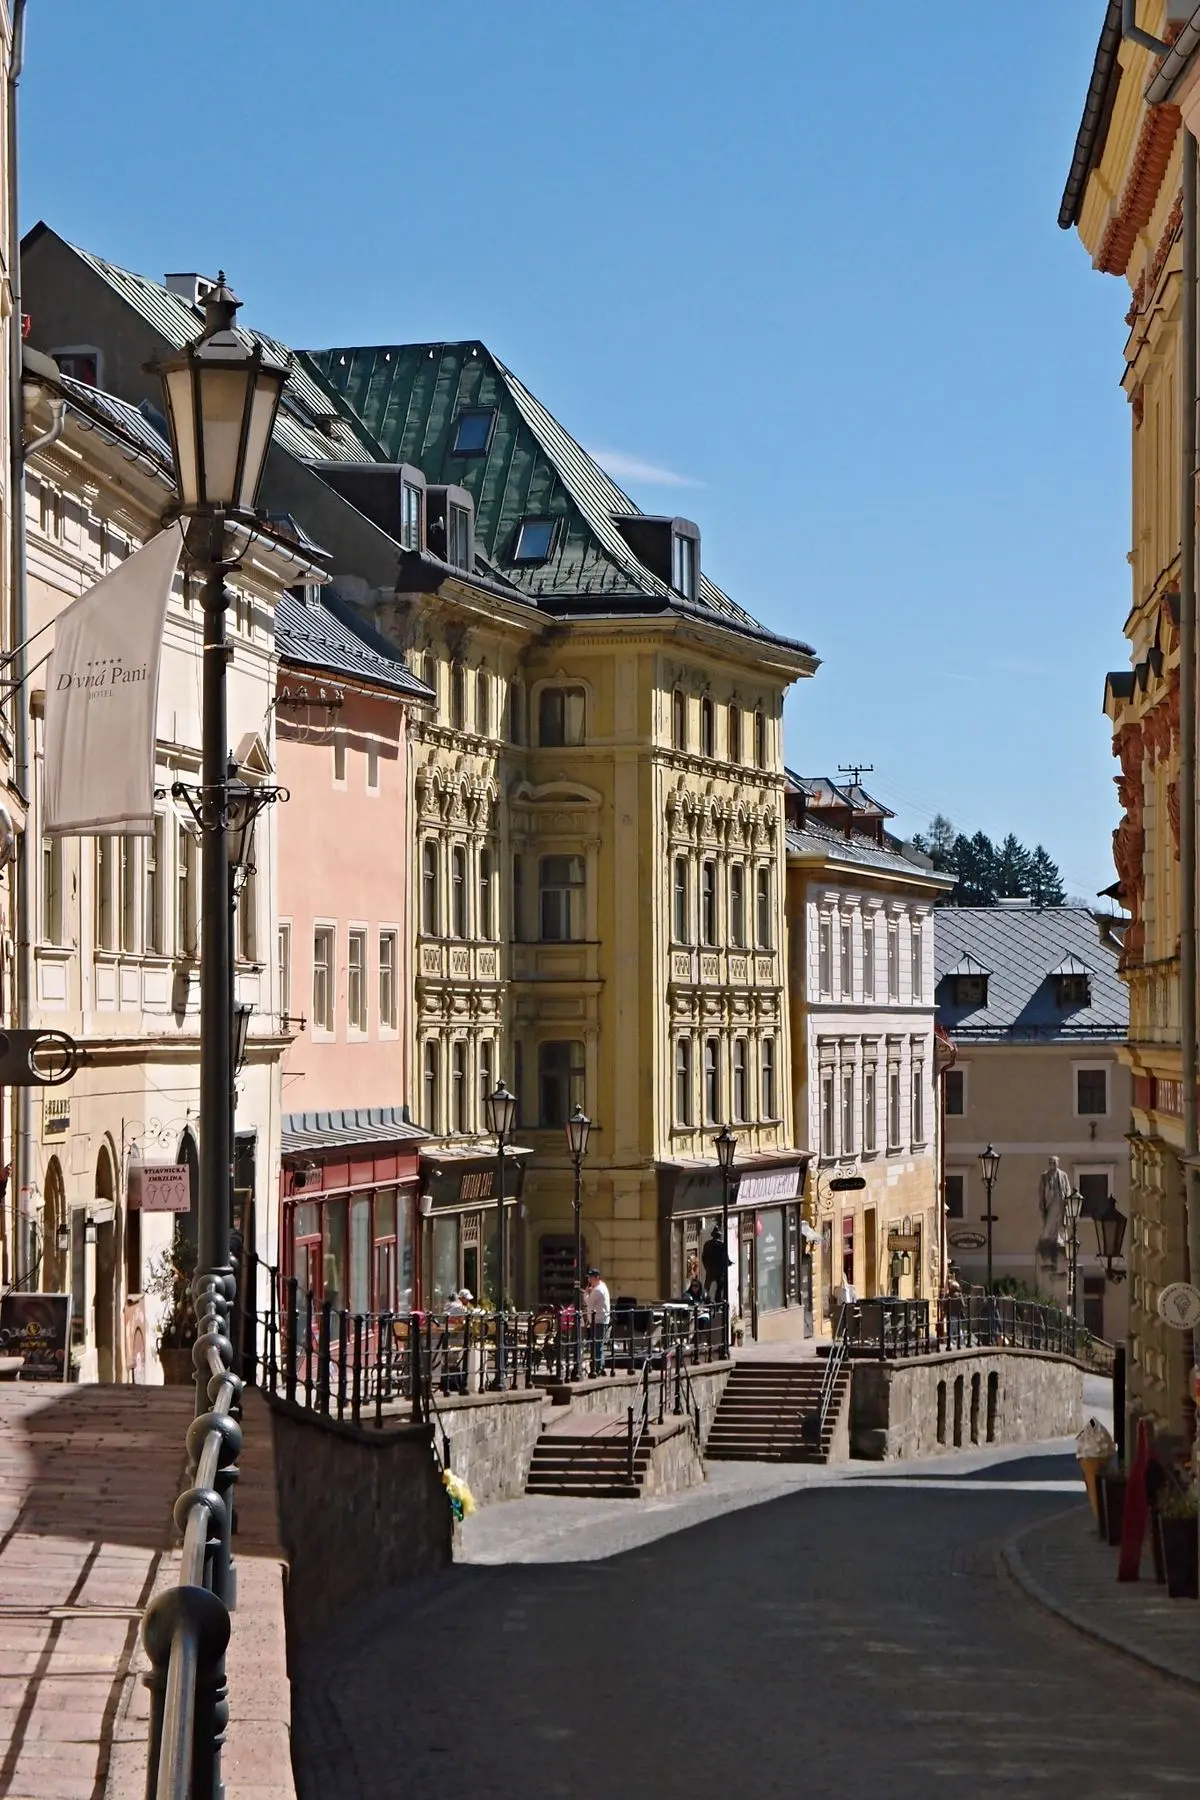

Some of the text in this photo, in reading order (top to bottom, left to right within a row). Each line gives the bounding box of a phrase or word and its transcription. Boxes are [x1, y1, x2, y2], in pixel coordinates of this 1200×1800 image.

[56, 663, 147, 691] Divná Pani
[88, 689, 113, 700] HOTEL
